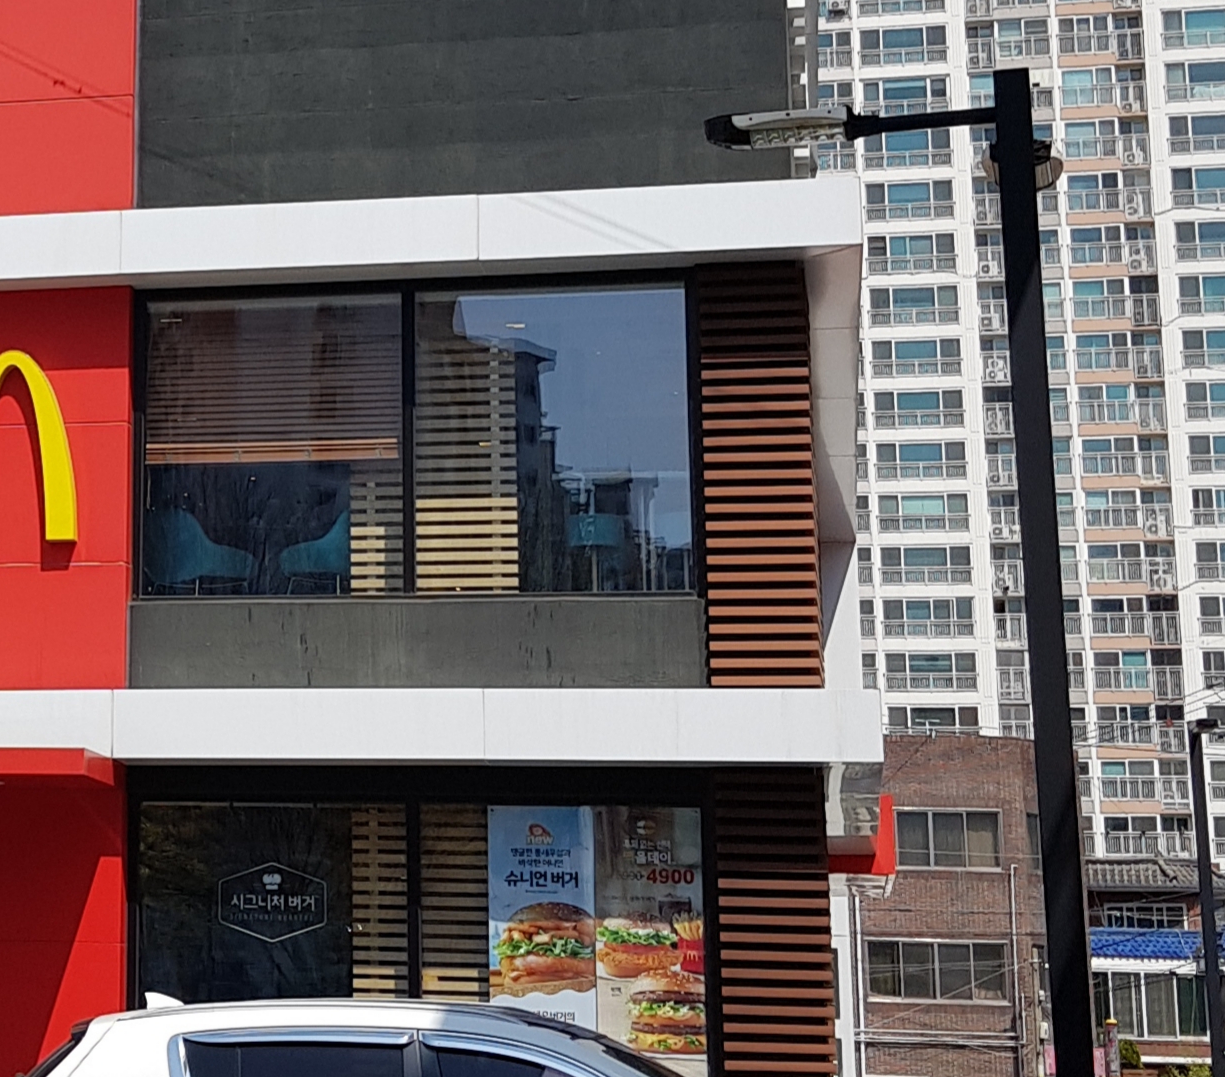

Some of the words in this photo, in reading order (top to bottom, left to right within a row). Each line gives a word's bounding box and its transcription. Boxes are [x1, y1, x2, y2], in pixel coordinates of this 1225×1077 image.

[526, 835, 553, 845] new
[504, 870, 548, 888] 슈니언
[550, 871, 579, 889] 버거
[646, 868, 695, 884] 4900
[230, 894, 285, 912] 시그니처
[288, 894, 316, 912] 버거
